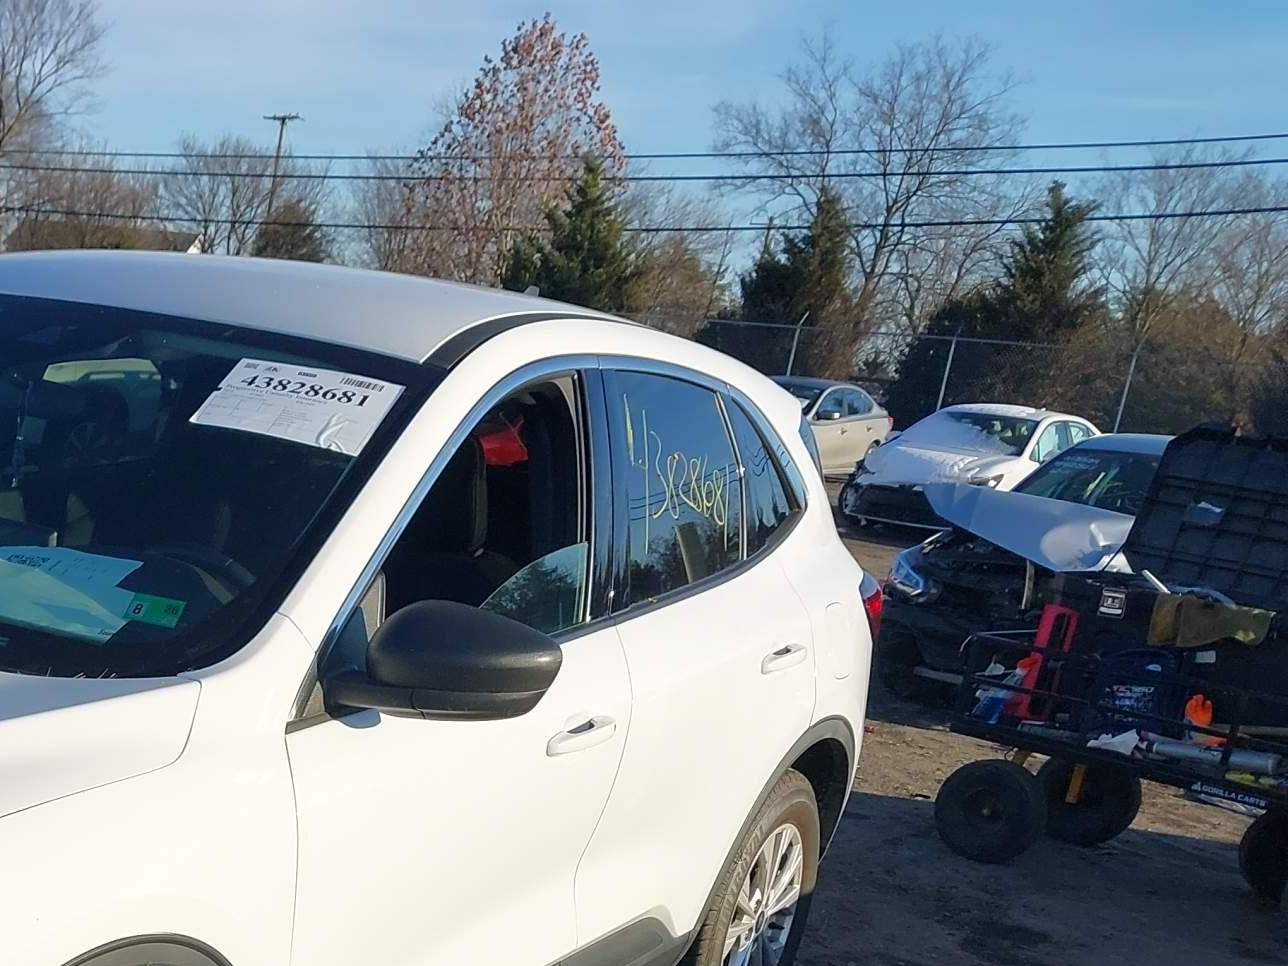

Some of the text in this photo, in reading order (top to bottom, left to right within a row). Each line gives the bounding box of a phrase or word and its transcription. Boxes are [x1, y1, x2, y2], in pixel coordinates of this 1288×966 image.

[241, 374, 371, 407] 43828681
[623, 393, 730, 555] 43828681
[132, 603, 144, 615] 8
